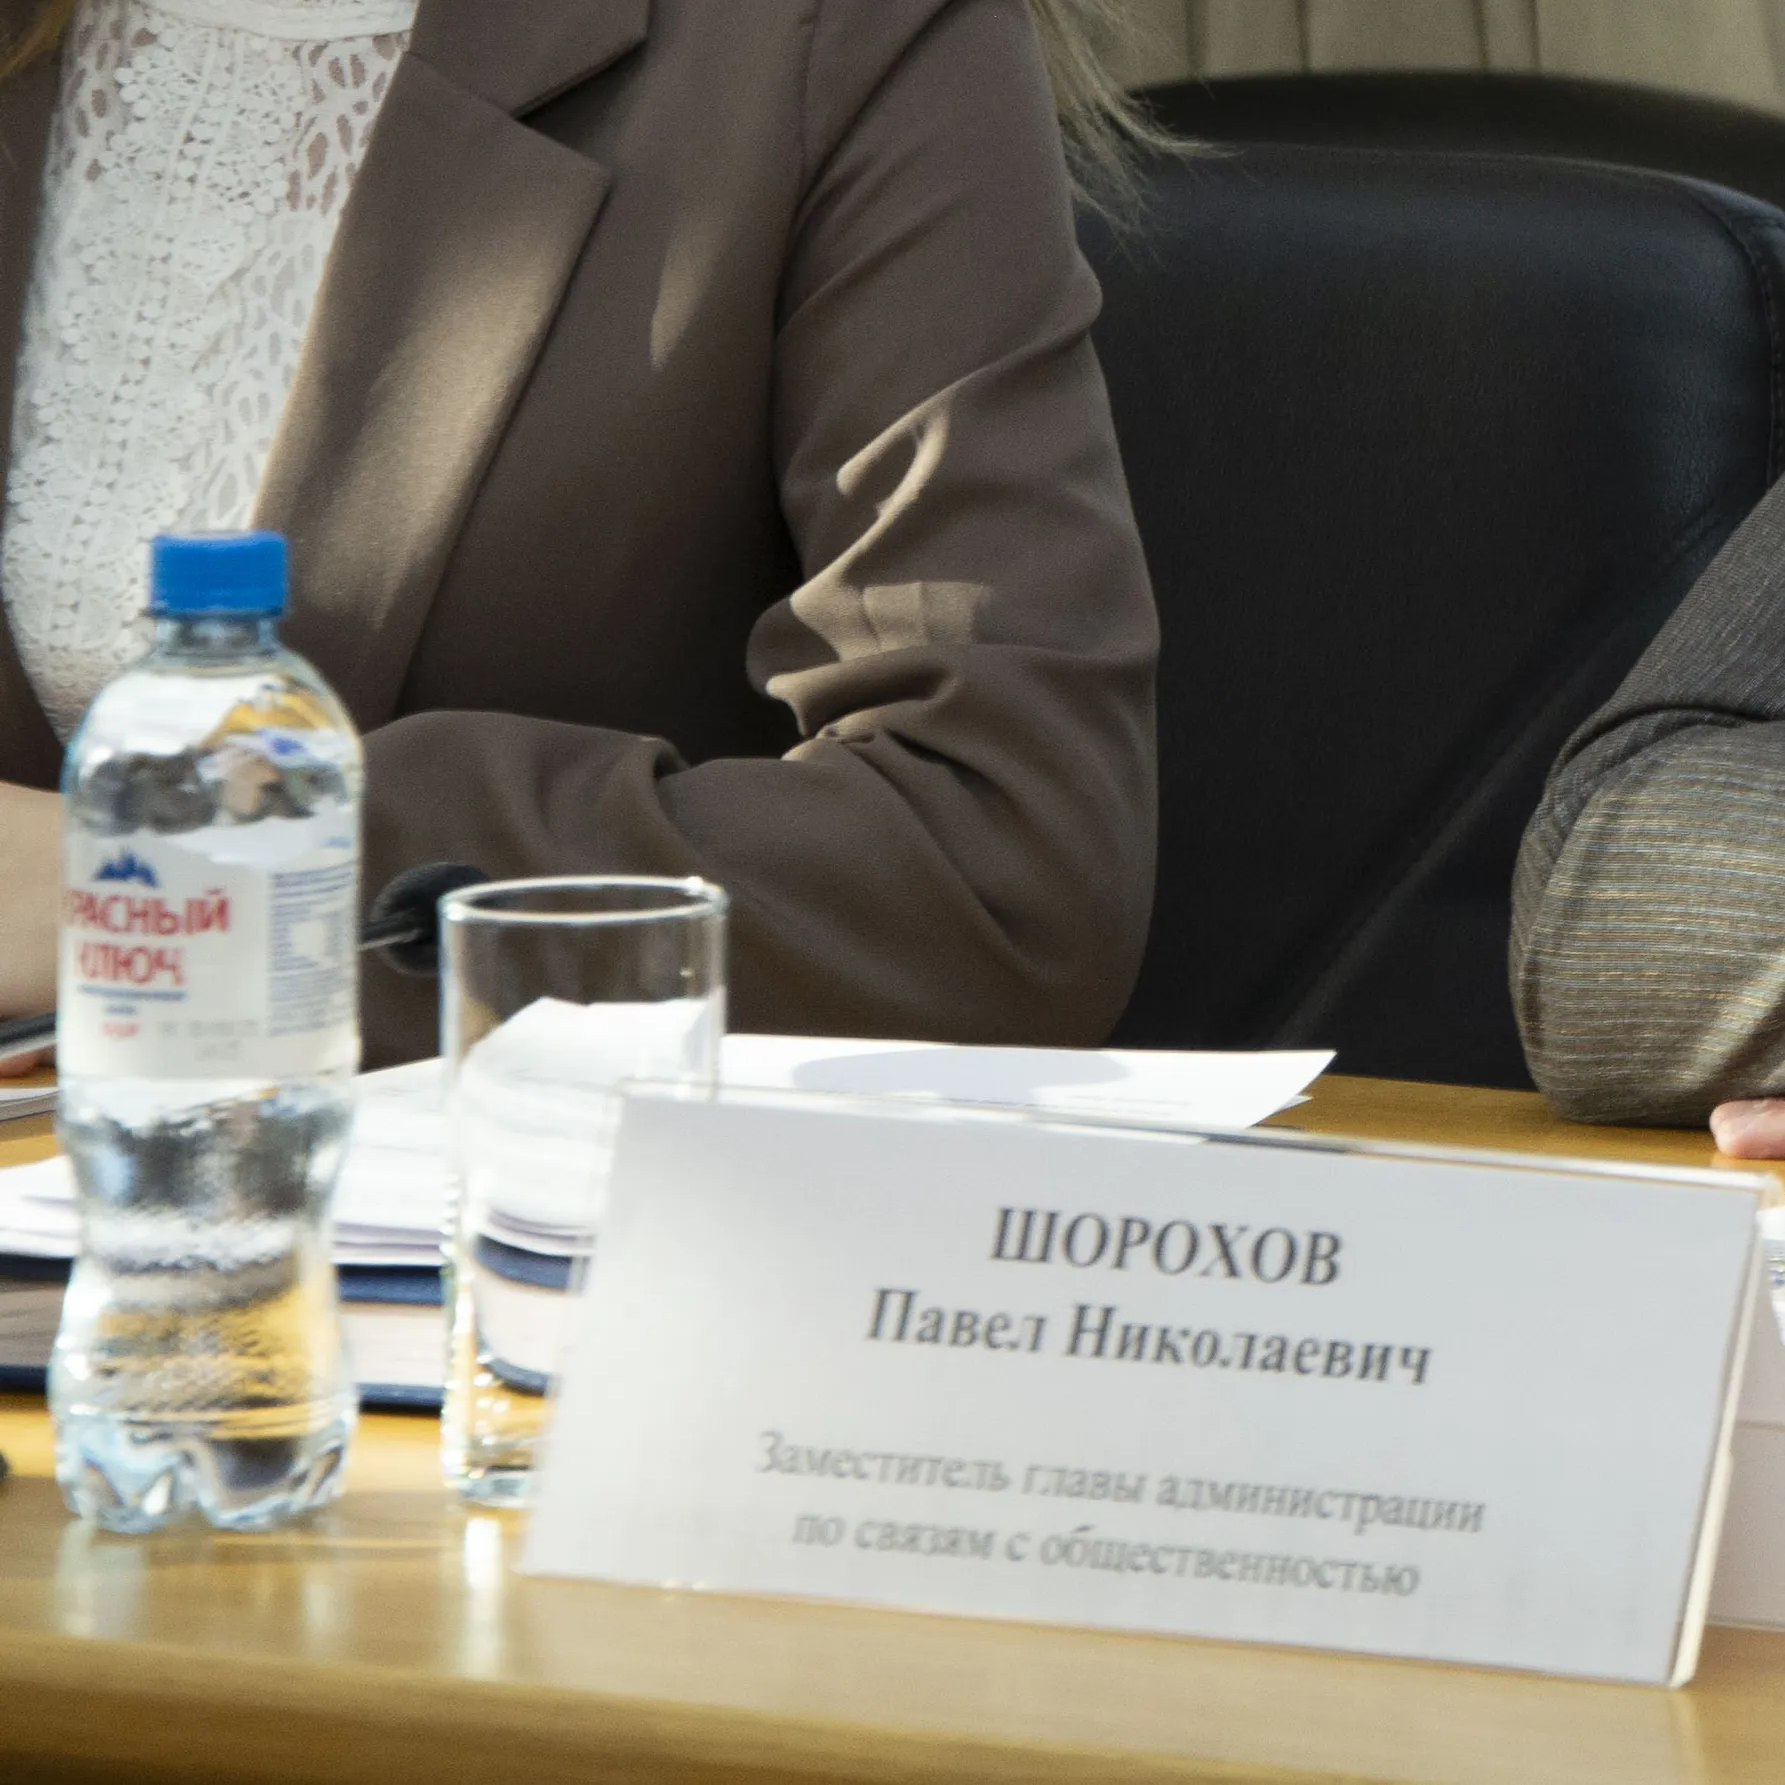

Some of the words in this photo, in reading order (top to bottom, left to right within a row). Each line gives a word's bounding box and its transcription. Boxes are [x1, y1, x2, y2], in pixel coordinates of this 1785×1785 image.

[64, 886, 233, 937] РАСНЫЙ
[988, 1204, 1345, 1288] ШОРОХОВ
[864, 1285, 1048, 1355] Павел
[1063, 1301, 1434, 1387] Николаевич
[758, 1429, 1012, 1493] Заместитель
[1020, 1464, 1147, 1504] главы
[1155, 1475, 1486, 1536] администрации
[794, 1514, 844, 1547] по
[854, 1521, 996, 1560] связям
[1004, 1534, 1034, 1564] с
[1039, 1524, 1421, 1598] общественностью
